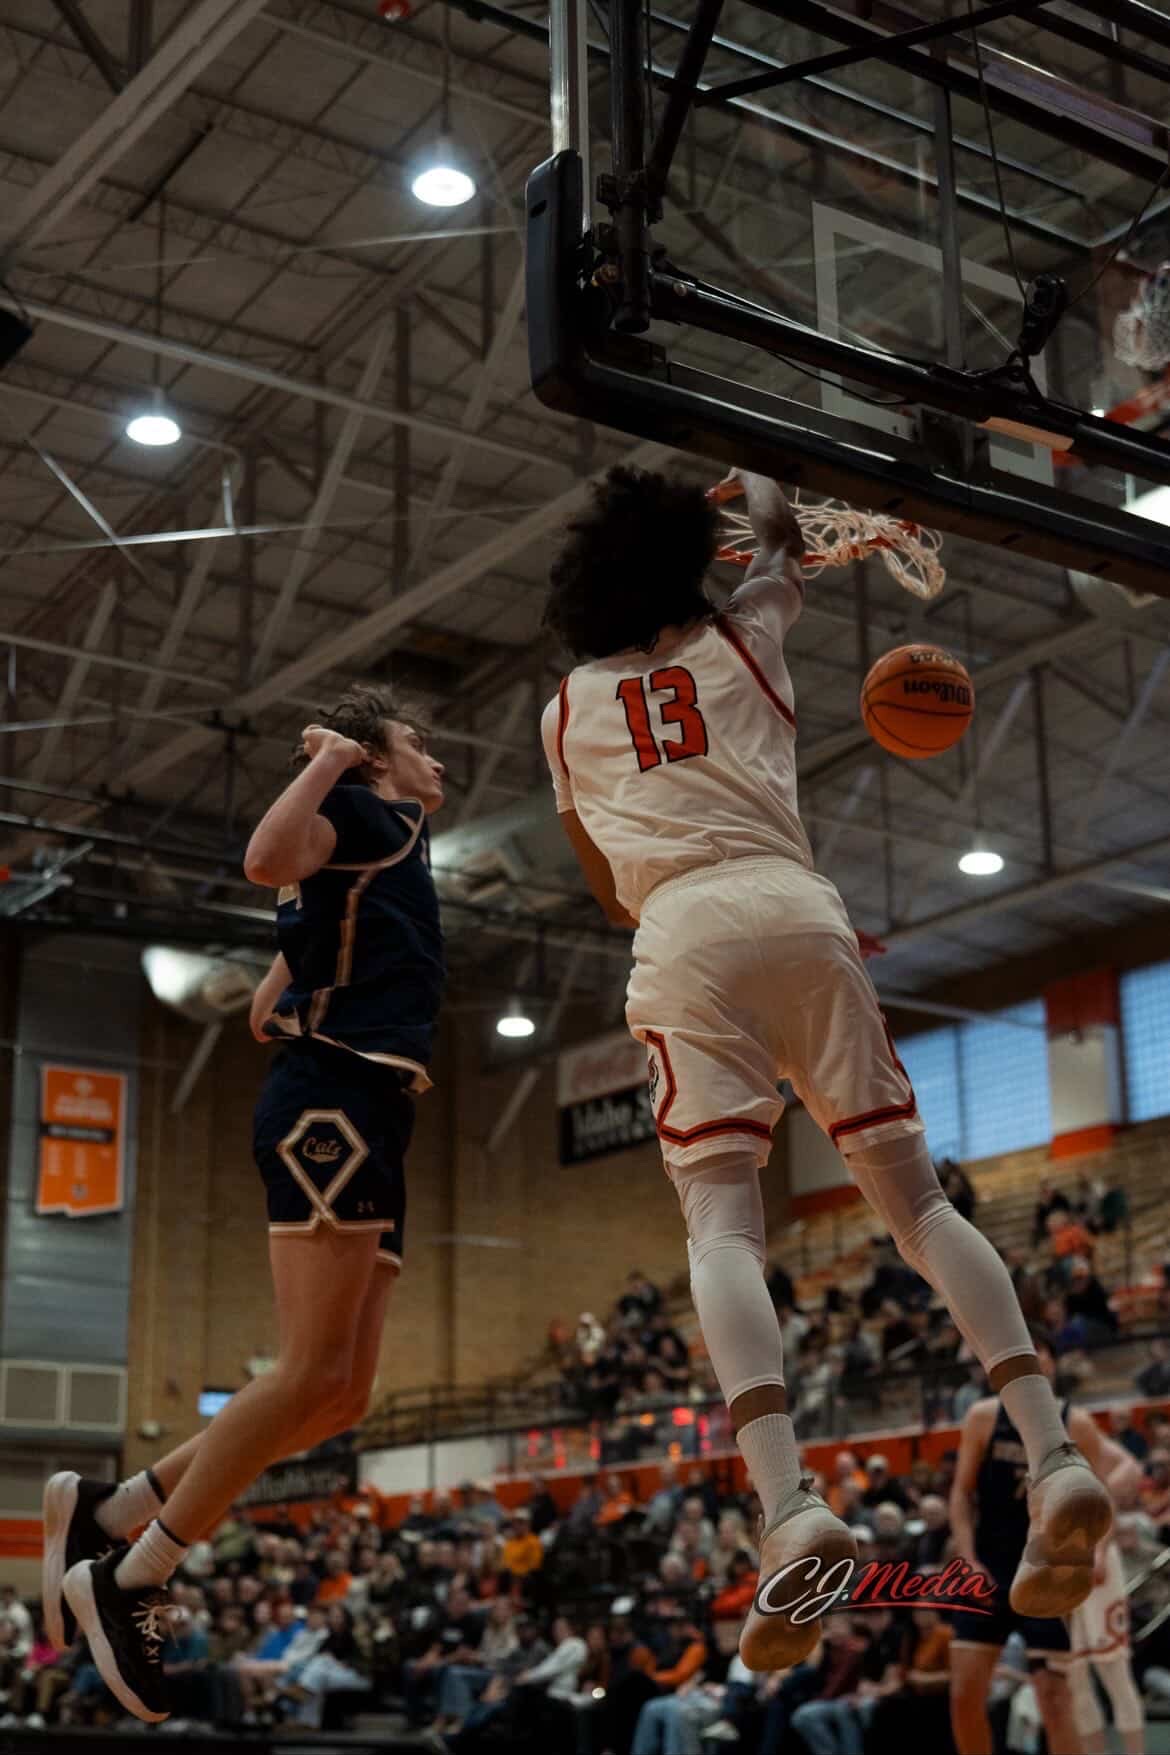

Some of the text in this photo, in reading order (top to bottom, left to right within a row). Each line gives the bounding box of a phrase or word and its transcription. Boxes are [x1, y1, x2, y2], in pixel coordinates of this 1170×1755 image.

[904, 680, 970, 706] Wilson
[616, 666, 709, 773] 13
[302, 1136, 344, 1160] Cats
